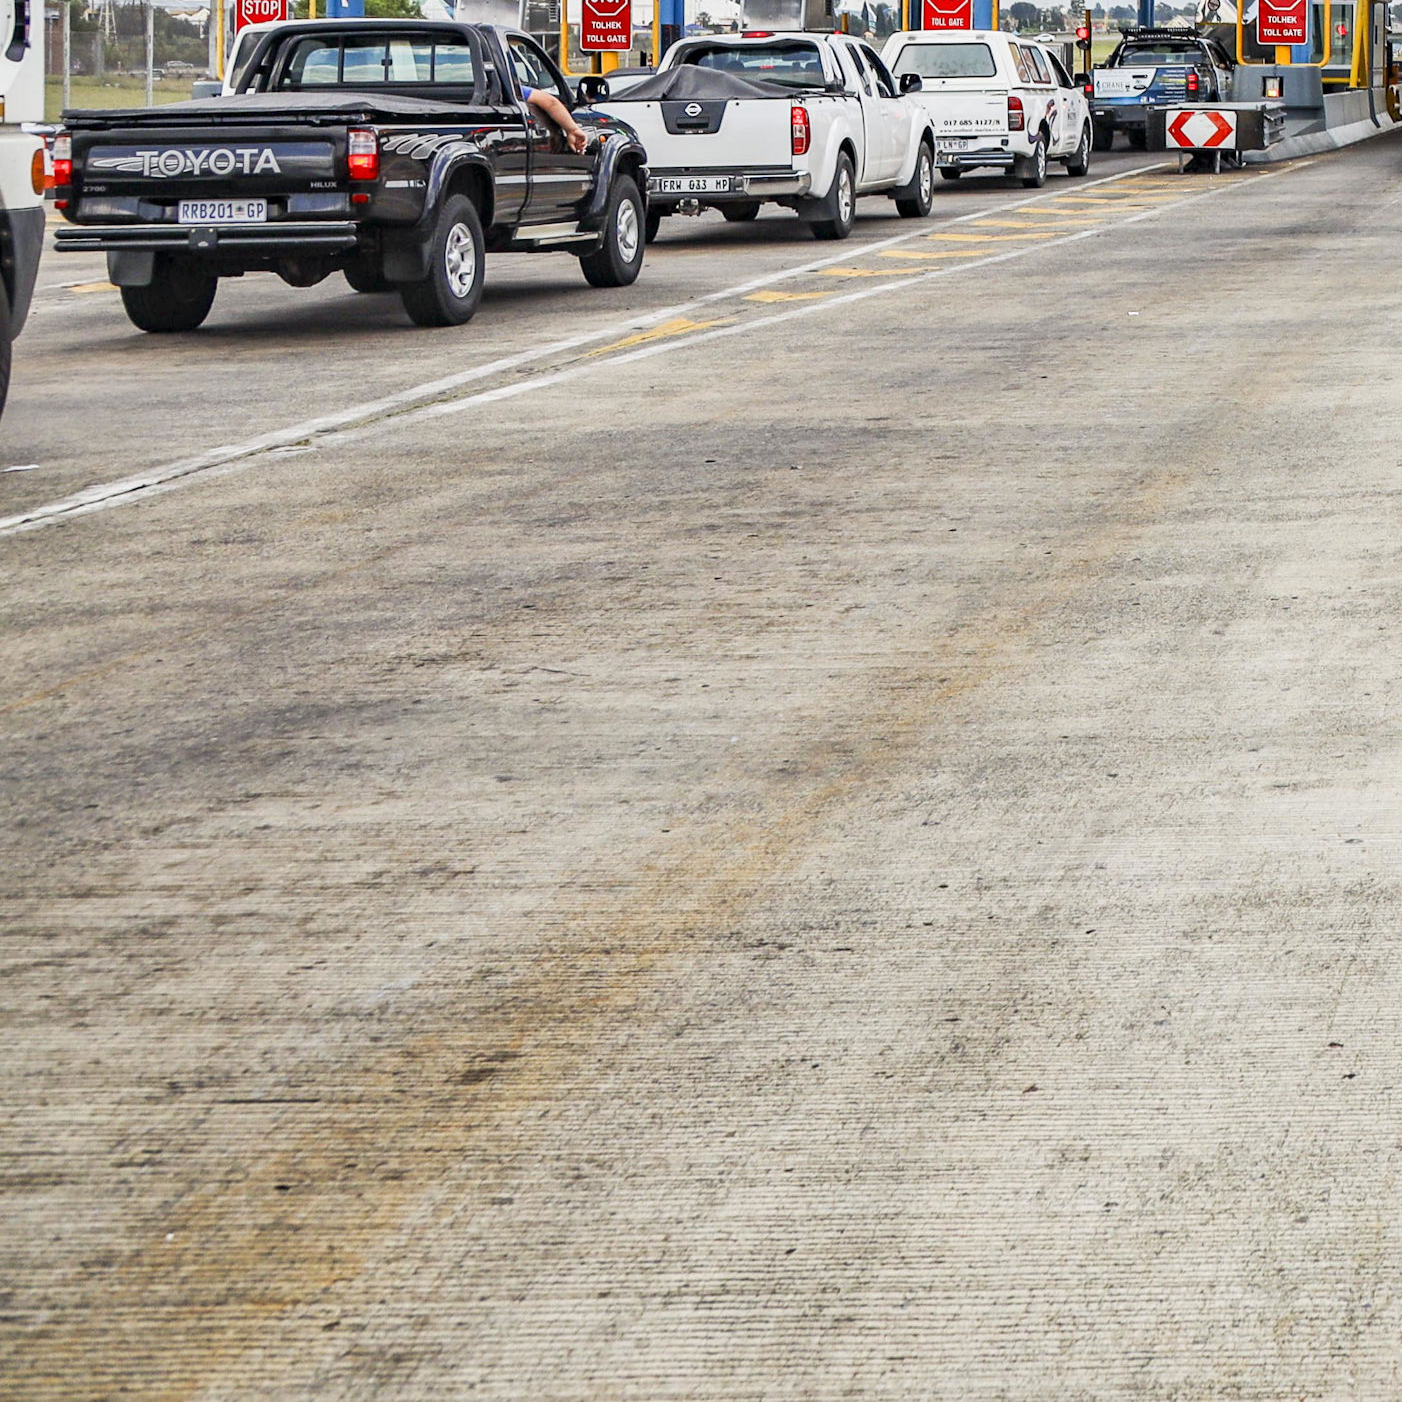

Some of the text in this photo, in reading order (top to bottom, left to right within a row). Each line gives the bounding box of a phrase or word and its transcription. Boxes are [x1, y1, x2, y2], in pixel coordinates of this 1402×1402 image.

[245, 0, 278, 15] STOP
[591, 20, 622, 29] TOLHEK
[931, 17, 965, 27] TOLL GATE
[1267, 15, 1298, 24] TOLHEK
[1263, 28, 1302, 37] TOLL GATE
[586, 34, 627, 43] TOLL GATE
[136, 148, 281, 177] TOYOTA
[663, 180, 682, 190] FRW
[716, 179, 728, 189] MP
[182, 202, 264, 220] RRB201 GP
